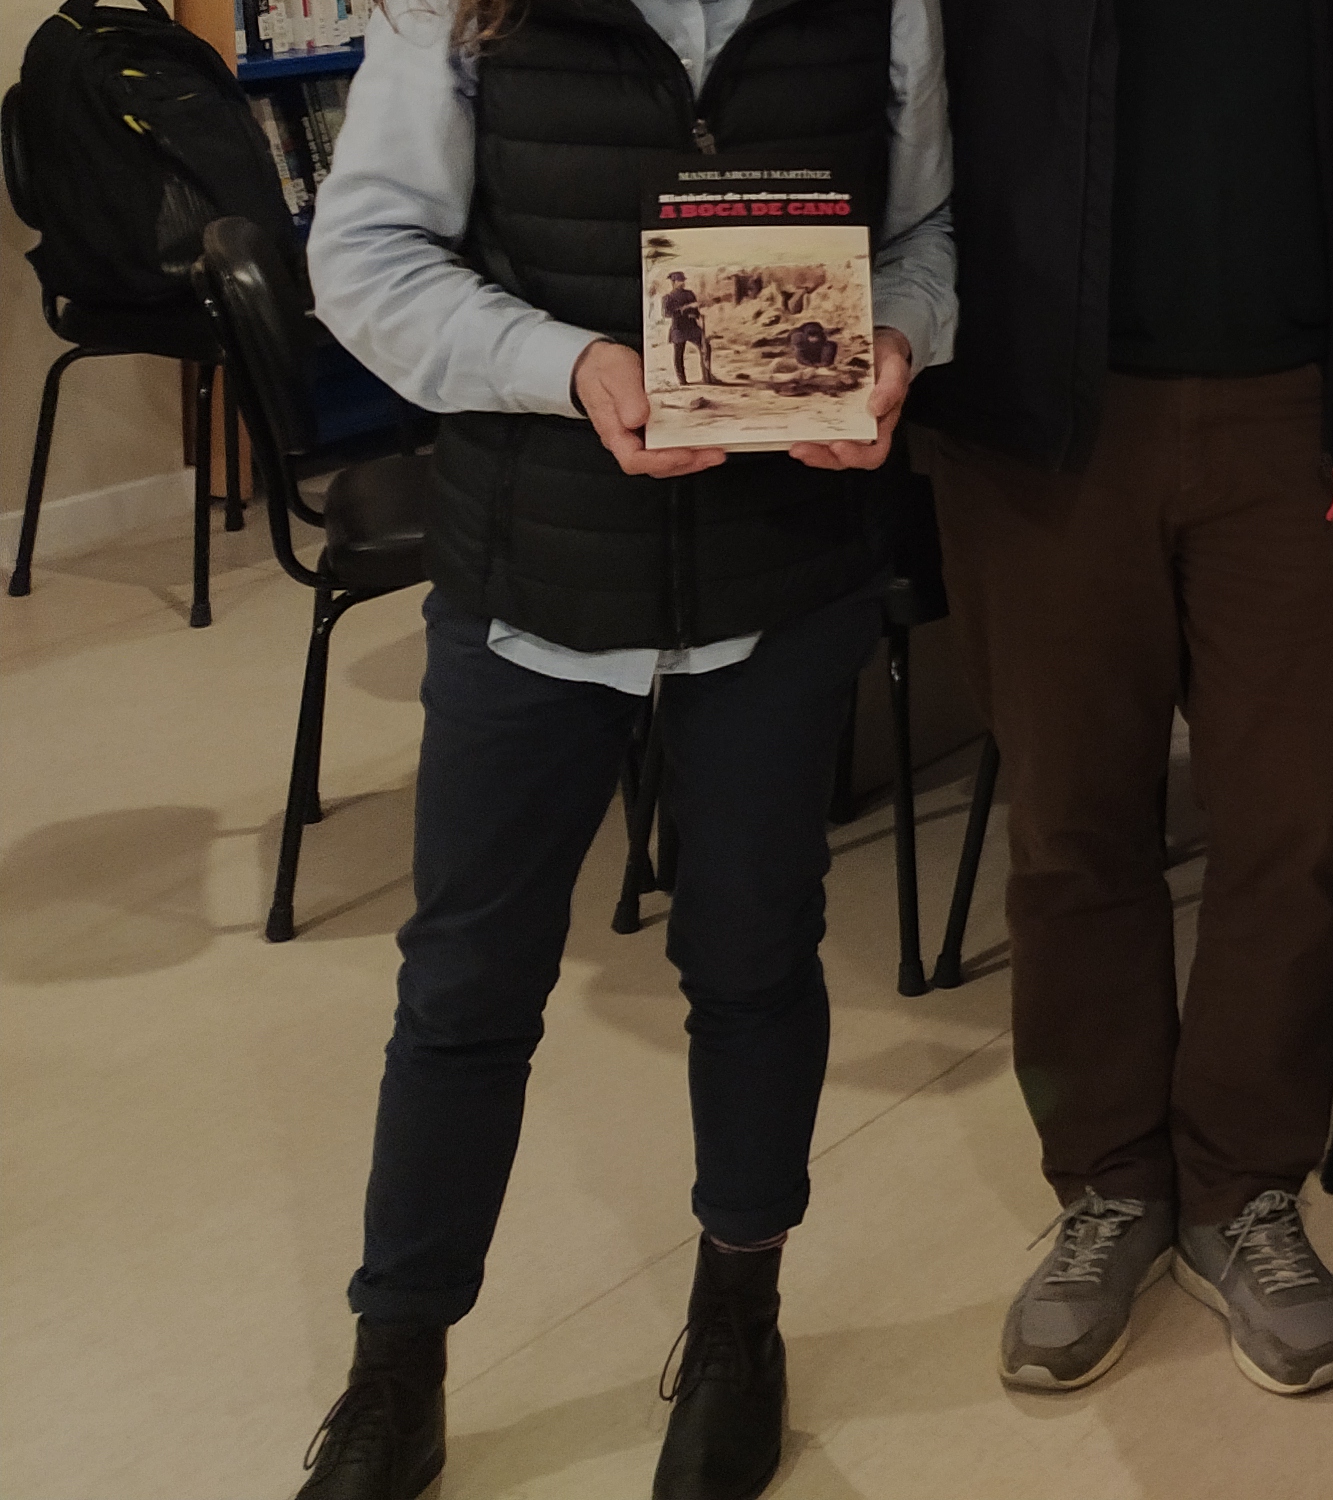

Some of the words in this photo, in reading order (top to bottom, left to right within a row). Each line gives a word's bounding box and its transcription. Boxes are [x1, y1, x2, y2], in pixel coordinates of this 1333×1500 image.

[679, 171, 721, 181] MANEL
[721, 171, 761, 180] ARCOS
[770, 169, 831, 179] MARTÍNEZ
[659, 204, 677, 218] A
[680, 203, 747, 217] BOCA
[751, 202, 783, 215] DE
[787, 200, 850, 215] CANÓ
